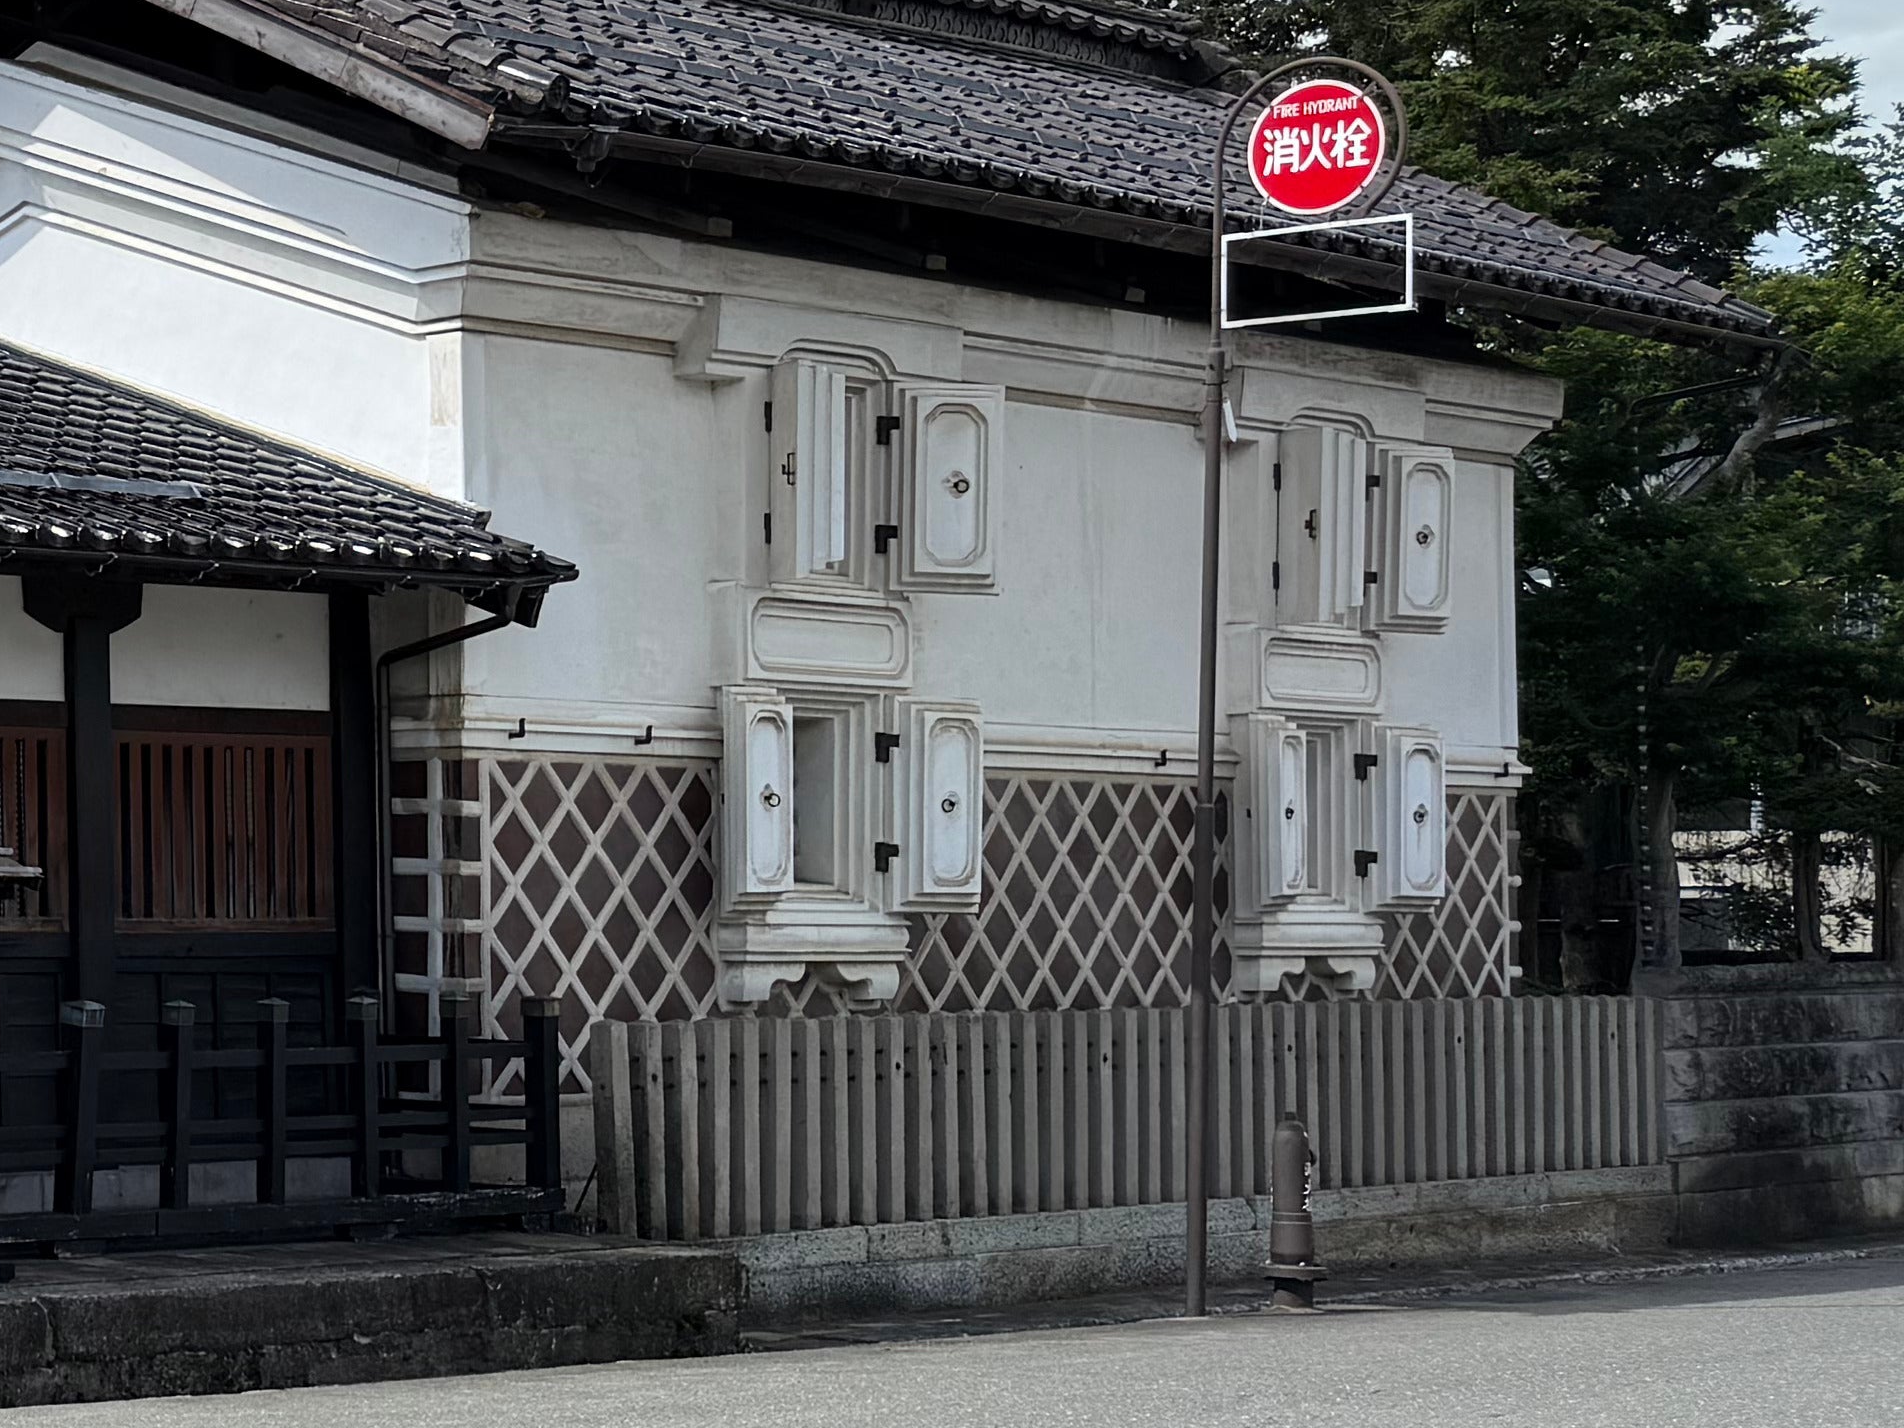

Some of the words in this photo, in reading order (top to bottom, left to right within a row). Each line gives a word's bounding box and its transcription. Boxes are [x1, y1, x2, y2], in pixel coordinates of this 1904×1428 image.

[1273, 103, 1300, 119] FIRE
[1303, 96, 1359, 116] HYDRANT
[1262, 117, 1372, 177] 消火栓
